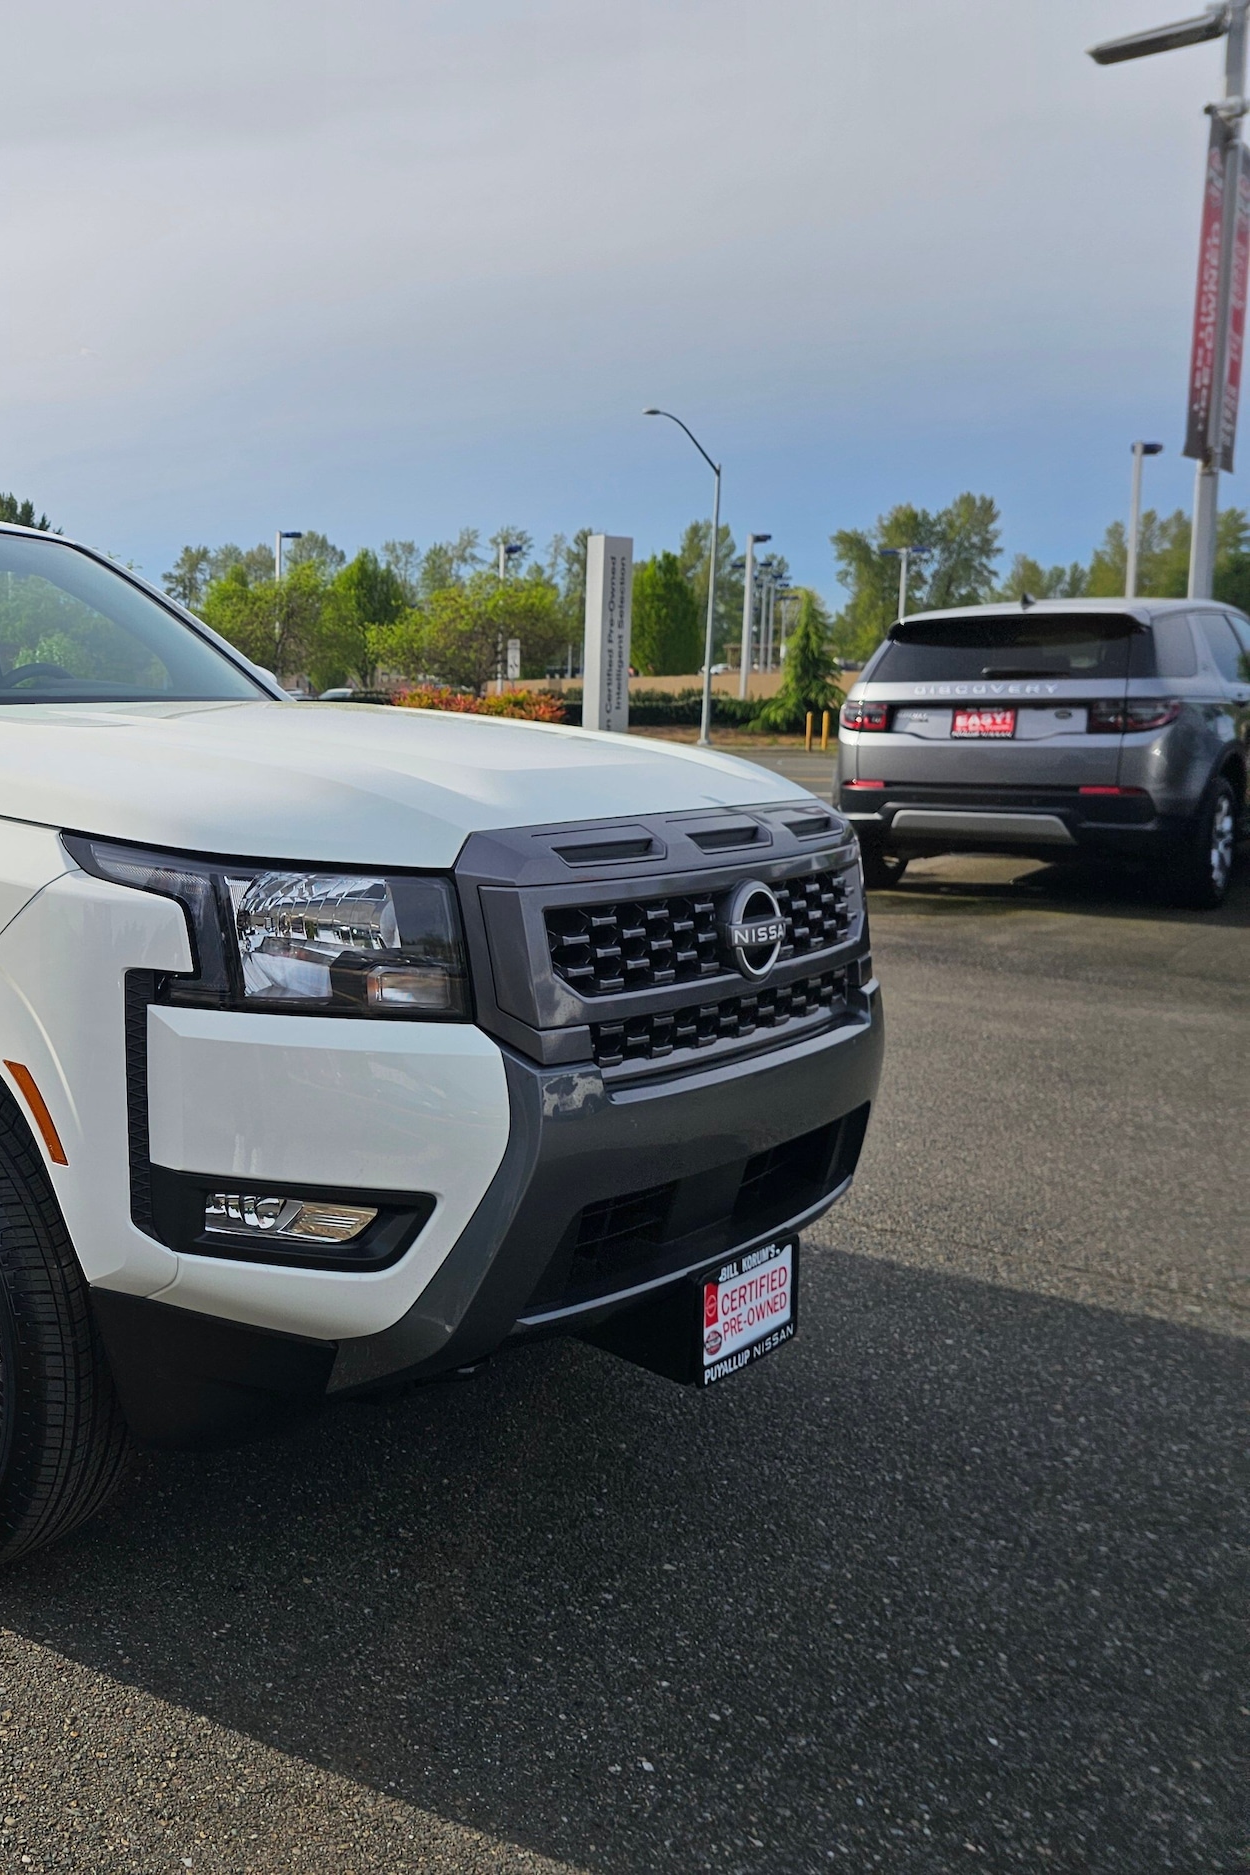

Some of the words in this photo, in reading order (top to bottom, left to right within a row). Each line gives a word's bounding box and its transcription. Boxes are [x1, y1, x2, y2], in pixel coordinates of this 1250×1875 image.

[607, 555, 617, 644] Pre-Owned
[617, 556, 626, 629] Selection
[605, 648, 615, 714] Certified
[615, 634, 625, 710] Intelligent
[913, 684, 1059, 696] DISCOVERY
[955, 711, 1012, 727] EASY!
[720, 1262, 739, 1281] BILL
[742, 1244, 777, 1272] KORUM'S
[721, 1266, 788, 1316] CERTIFIED
[722, 1291, 787, 1342] PRE-OWNED
[704, 1349, 750, 1386] PUYALLUP
[753, 1323, 794, 1358] NISSAN
